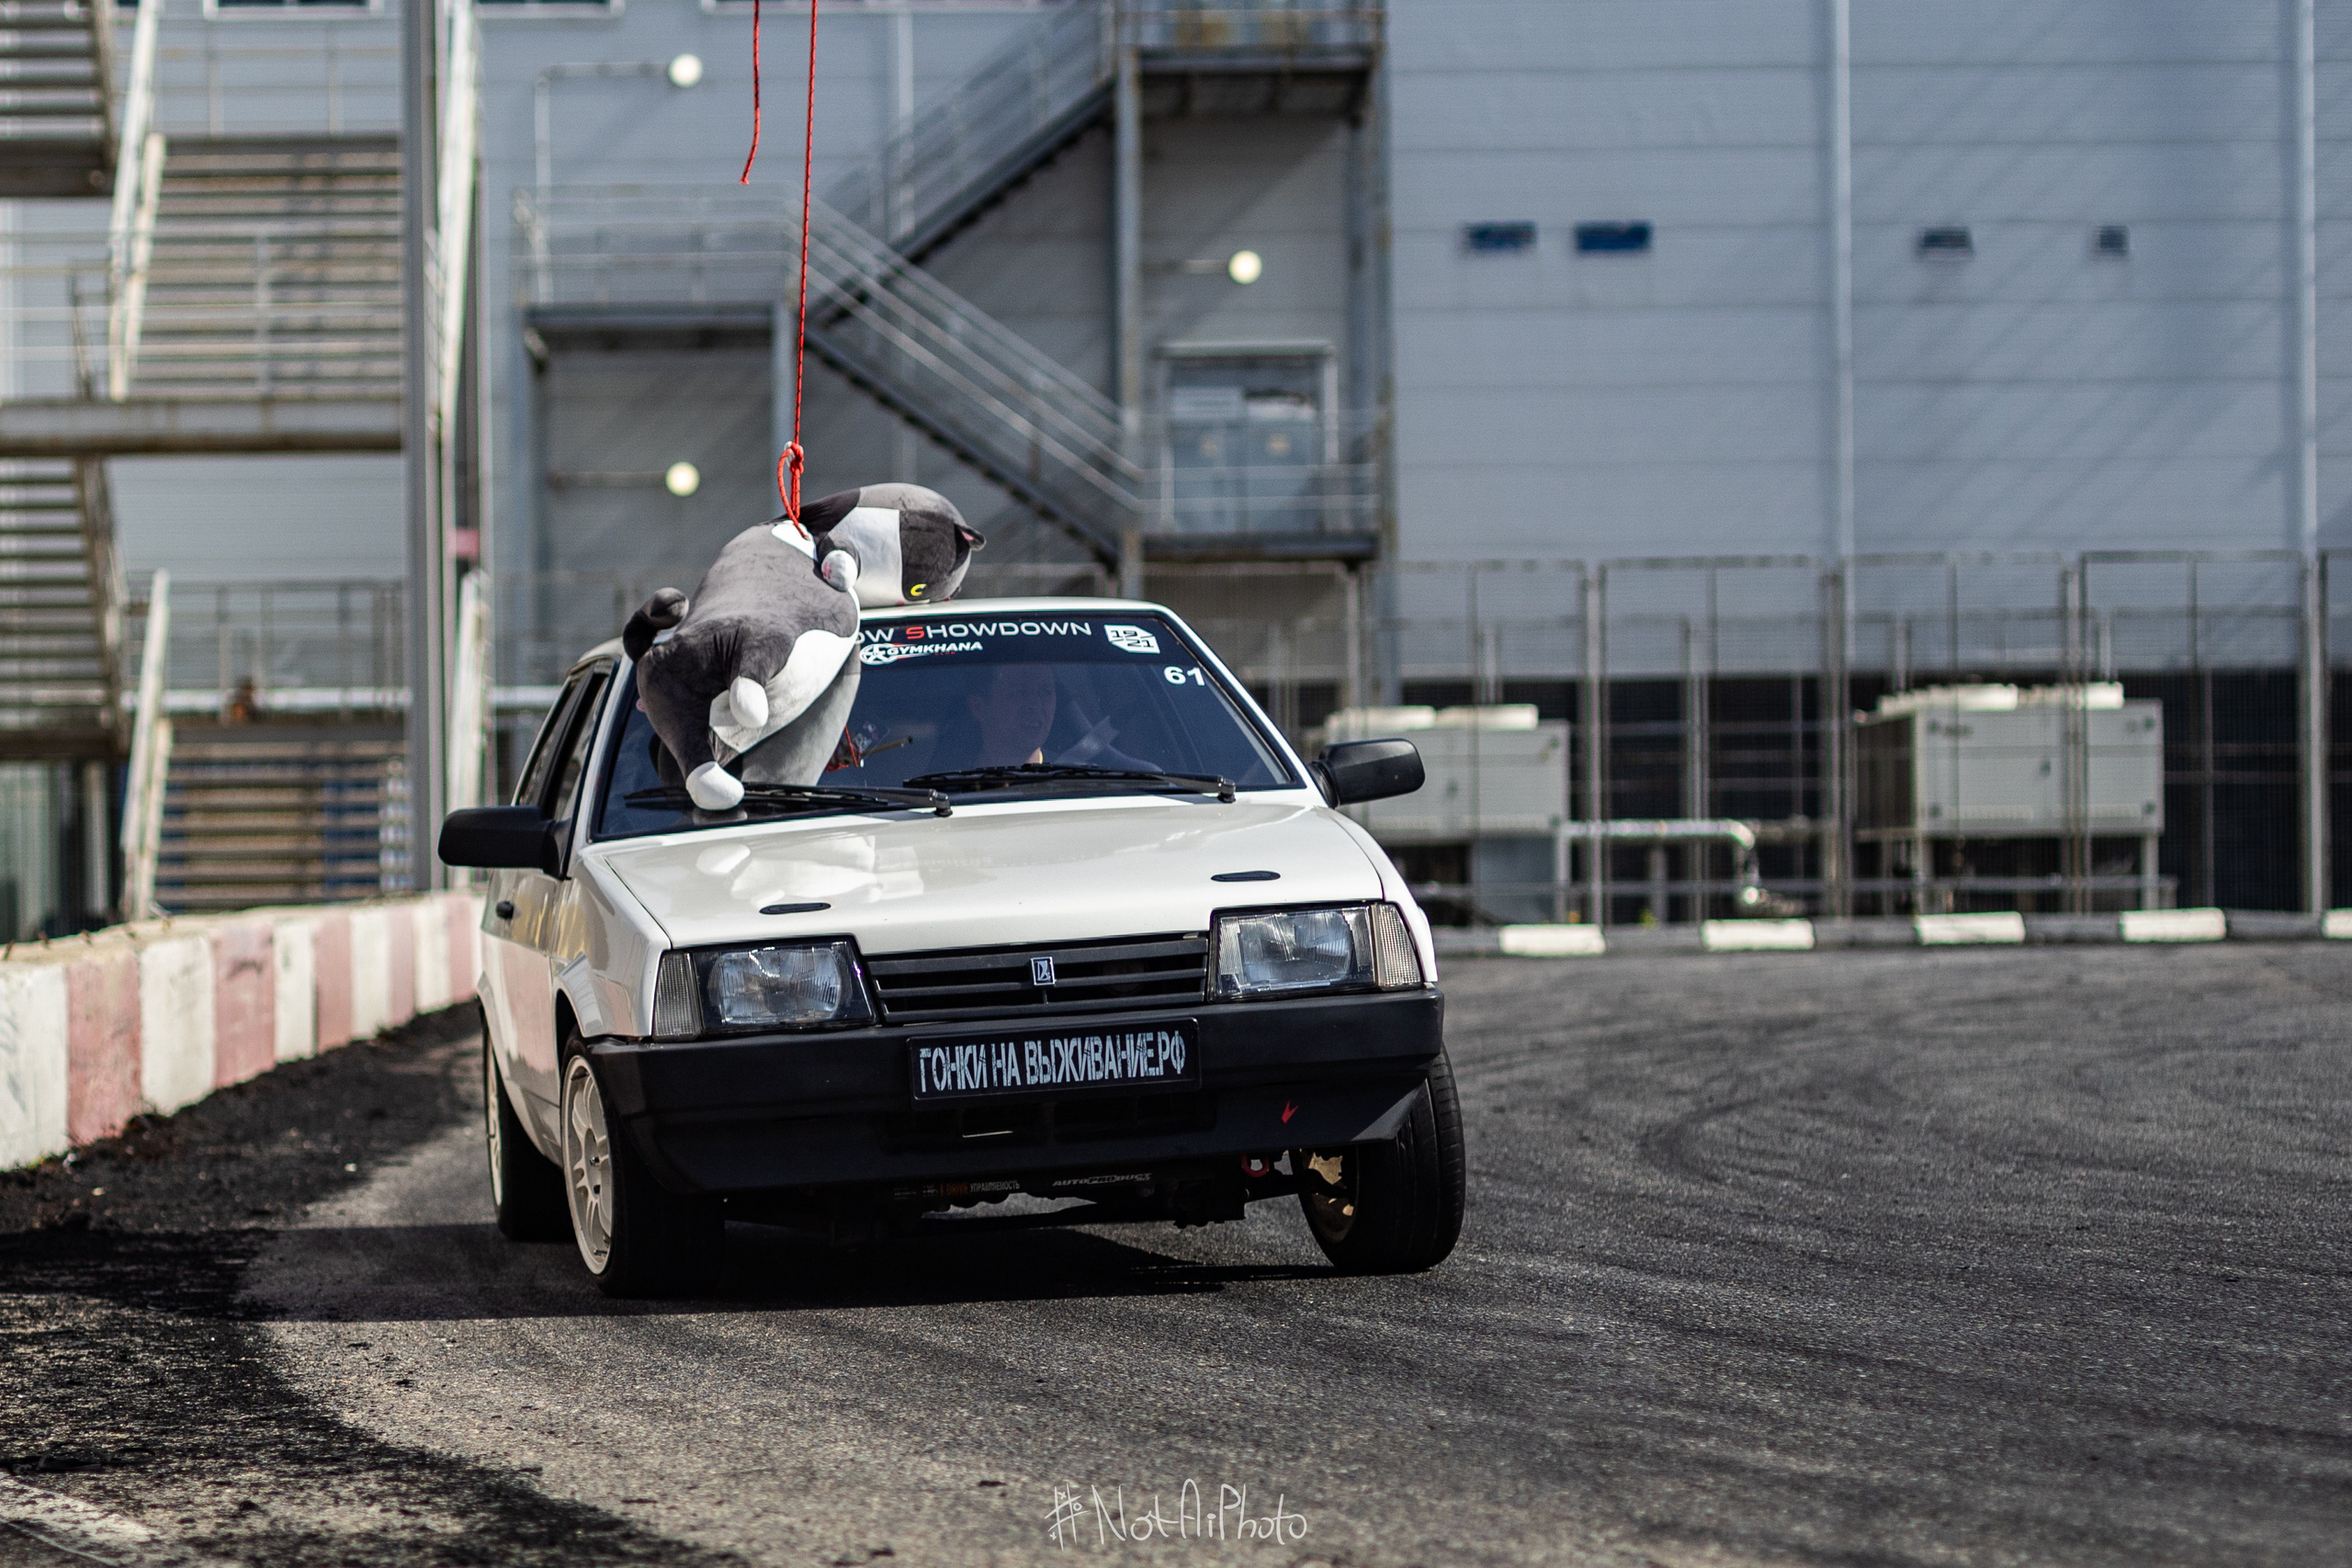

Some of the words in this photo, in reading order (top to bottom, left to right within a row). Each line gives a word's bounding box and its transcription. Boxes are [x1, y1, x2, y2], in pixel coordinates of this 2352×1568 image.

[905, 621, 1092, 640] SHOWDOWN
[887, 641, 983, 656] GYMKHANA
[1163, 665, 1205, 686] 61
[919, 1043, 988, 1093] ГОНКИ
[990, 1041, 1022, 1087] НА
